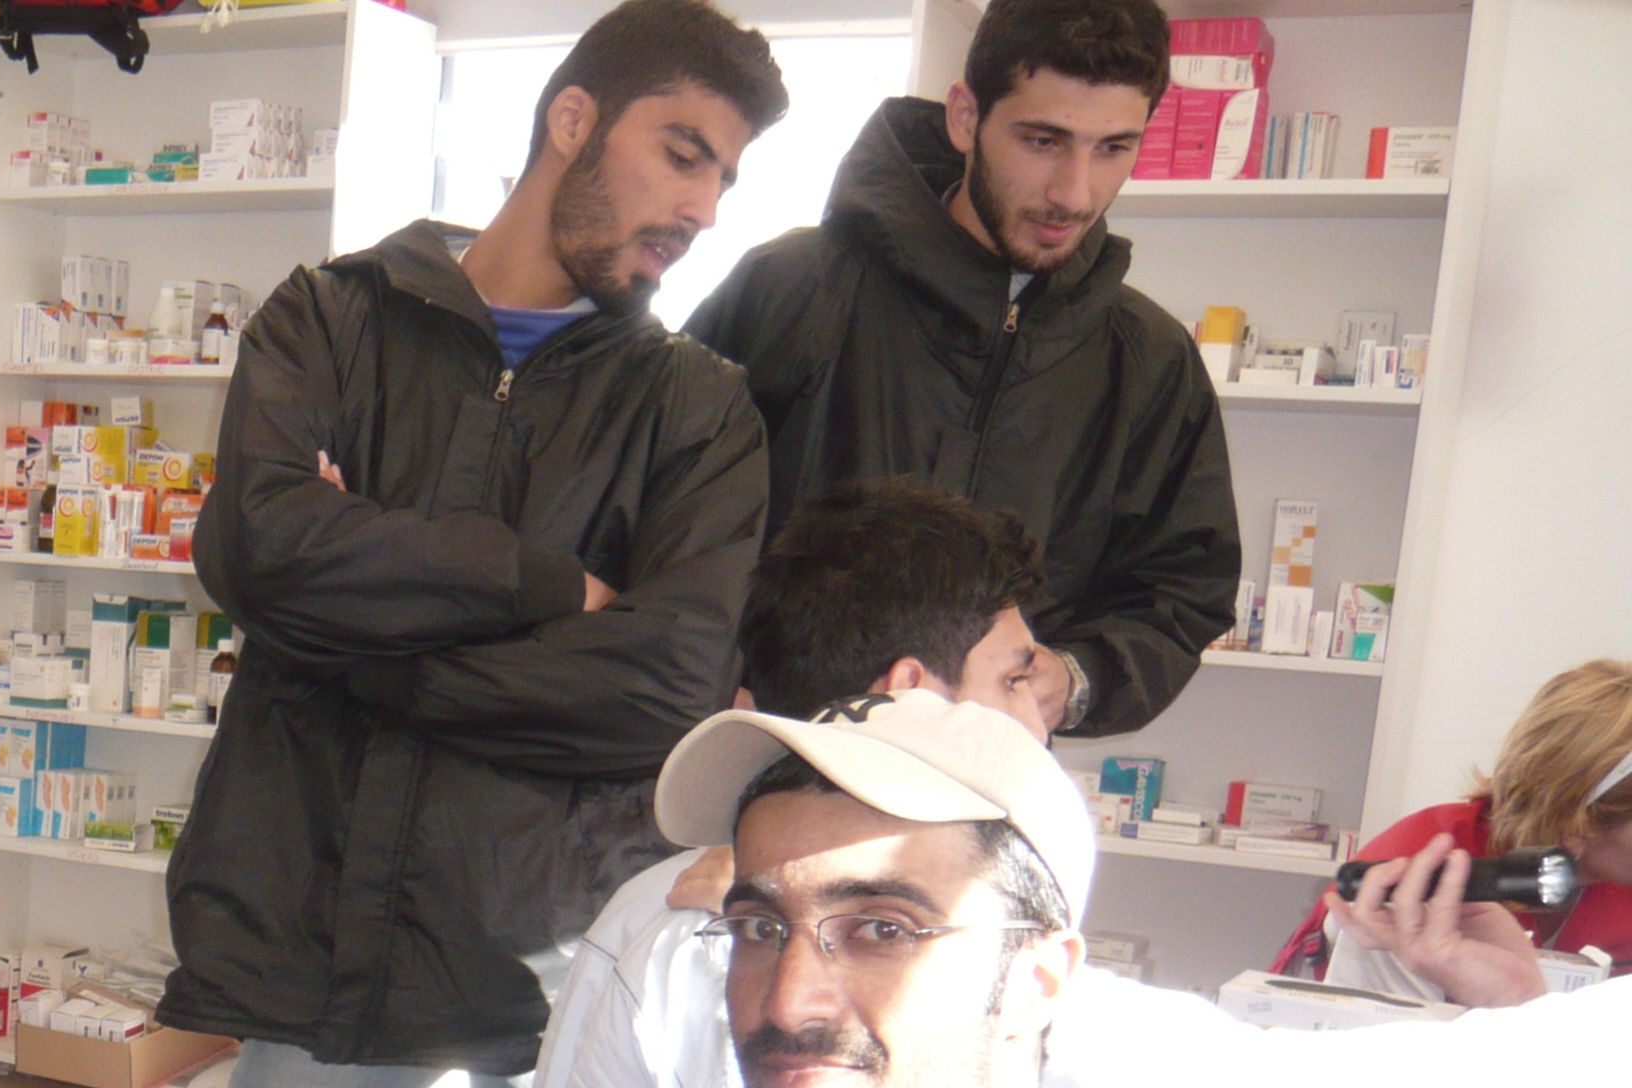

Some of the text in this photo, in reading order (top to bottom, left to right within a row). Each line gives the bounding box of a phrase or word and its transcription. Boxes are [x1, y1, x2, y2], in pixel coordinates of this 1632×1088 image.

[139, 452, 165, 462] DEPON
[58, 488, 79, 496] DEPON
[132, 537, 158, 546] DEPON
[1134, 764, 1149, 820] GAVISCO
[156, 809, 185, 820] trebon
